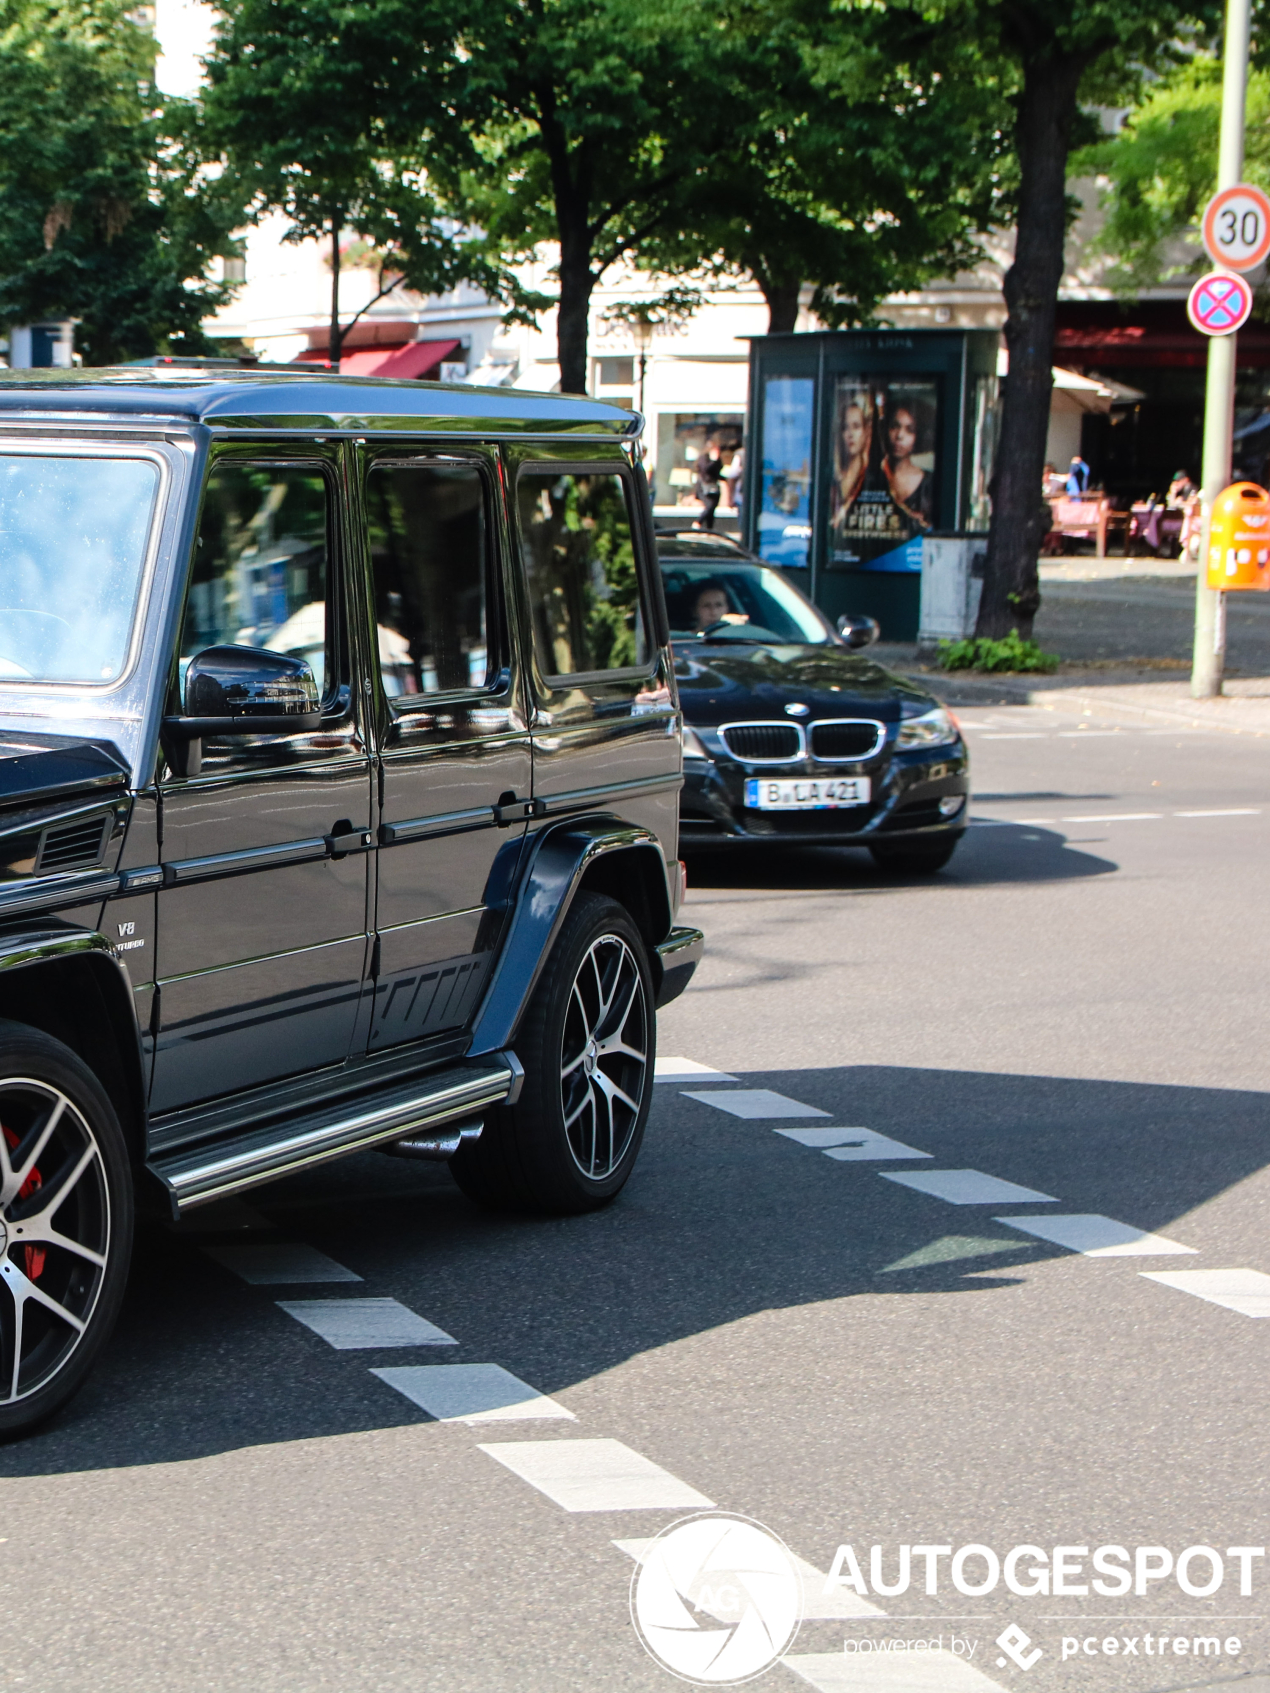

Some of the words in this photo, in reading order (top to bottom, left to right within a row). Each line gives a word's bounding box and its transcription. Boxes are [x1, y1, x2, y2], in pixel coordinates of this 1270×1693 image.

[1219, 210, 1259, 245] 30
[849, 514, 899, 530] FIRES
[768, 784, 779, 802] B
[826, 782, 859, 800] 421
[117, 921, 135, 937] V8
